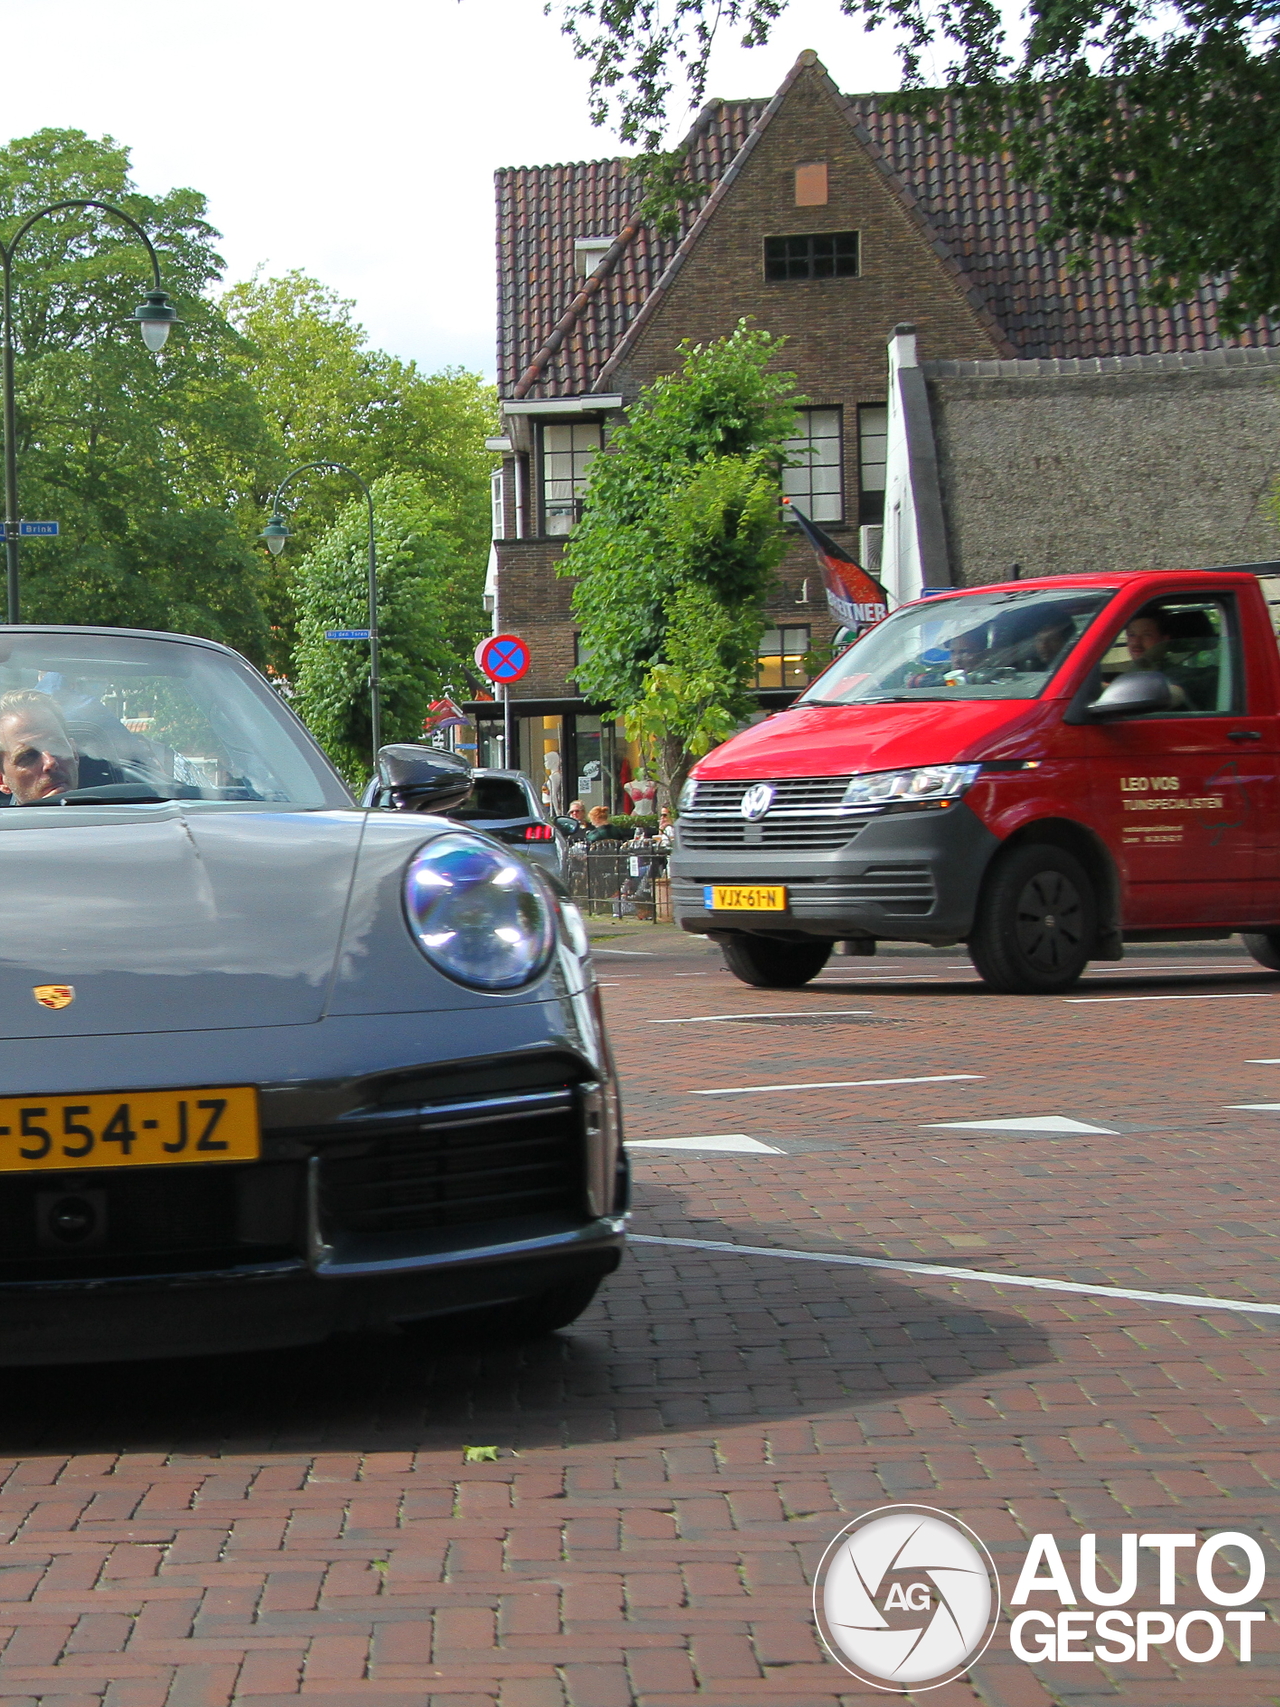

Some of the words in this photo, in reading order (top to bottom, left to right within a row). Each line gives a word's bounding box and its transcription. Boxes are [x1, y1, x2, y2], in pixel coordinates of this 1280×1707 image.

[25, 525, 53, 533] Brink
[1120, 776, 1149, 792] LEO
[1149, 776, 1180, 791] VOS
[1122, 797, 1223, 811] TUINSPECIALISTEN
[718, 889, 776, 907] VJX-61-N
